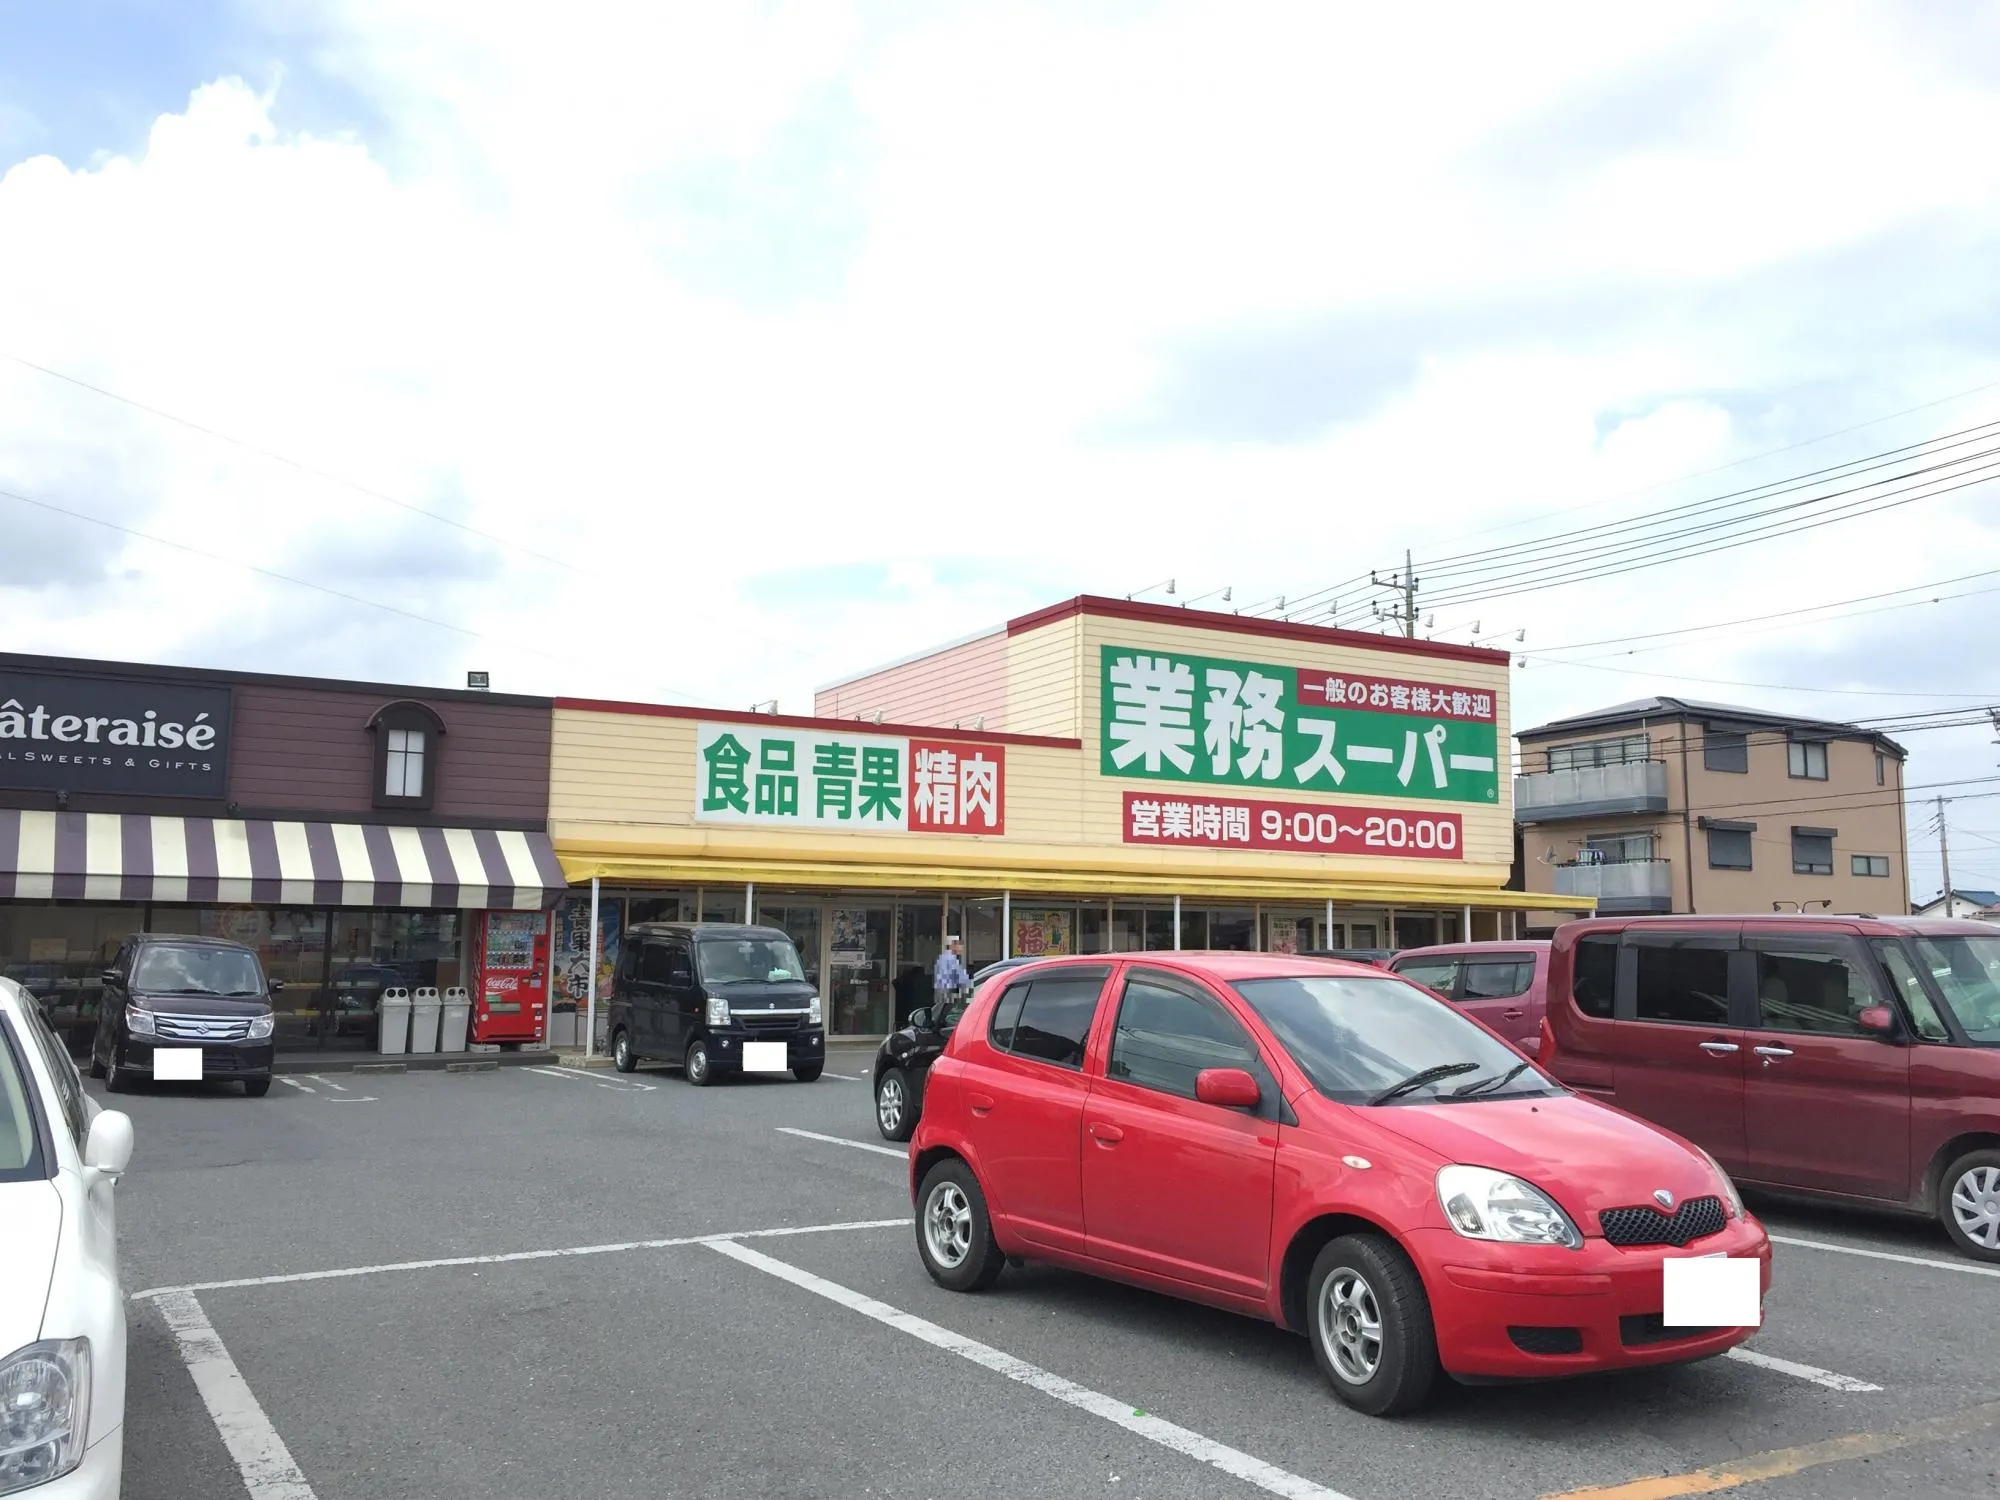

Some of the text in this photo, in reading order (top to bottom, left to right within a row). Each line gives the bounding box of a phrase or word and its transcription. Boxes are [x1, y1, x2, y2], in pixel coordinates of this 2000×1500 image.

[1303, 676, 1492, 718] 一般のお客様大歓迎
[1109, 655, 1494, 788] 業務スーパー
[24, 752, 112, 765] SWEETS
[124, 758, 136, 767] &
[148, 759, 212, 771] GIFTS
[702, 733, 998, 828] 食品 青果 精肉
[1131, 800, 1250, 842] 営業時間
